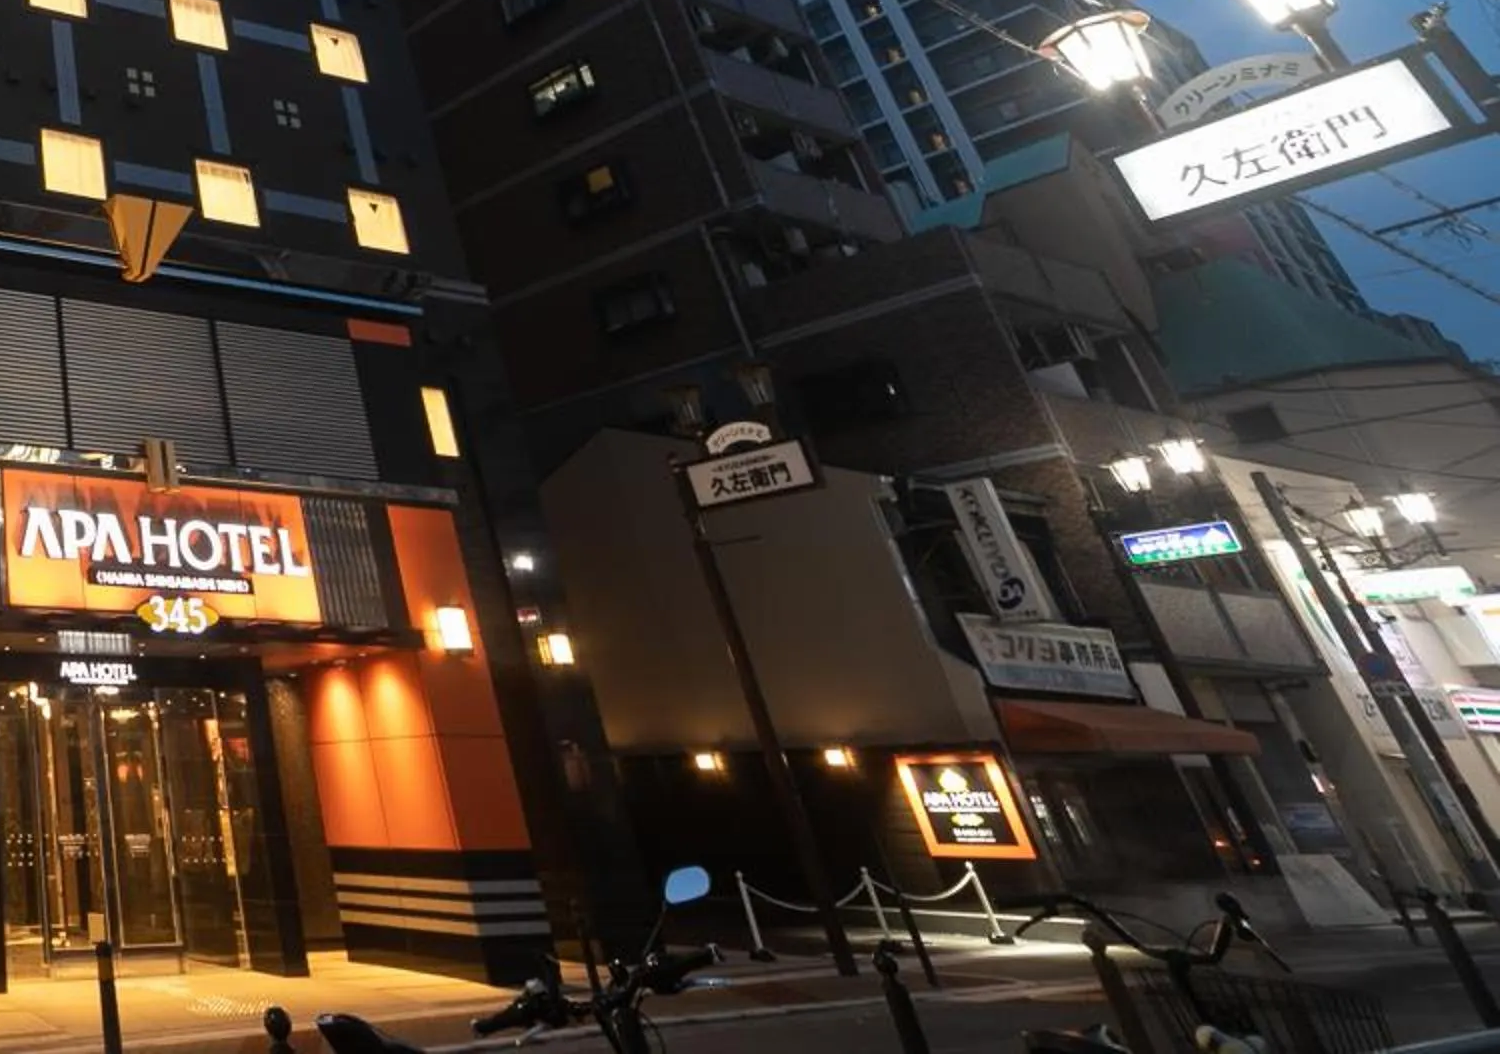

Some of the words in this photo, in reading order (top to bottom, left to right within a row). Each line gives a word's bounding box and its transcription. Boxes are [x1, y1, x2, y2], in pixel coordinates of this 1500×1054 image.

[1173, 61, 1300, 116] クリーンミナミ
[1181, 106, 1388, 196] 久左衛門
[711, 461, 792, 497] 久左衛門
[20, 506, 133, 564] APA
[139, 515, 309, 577] HOTEL
[149, 596, 208, 634] 345
[90, 662, 137, 681] HOTEL
[950, 791, 999, 807] HOTEL
